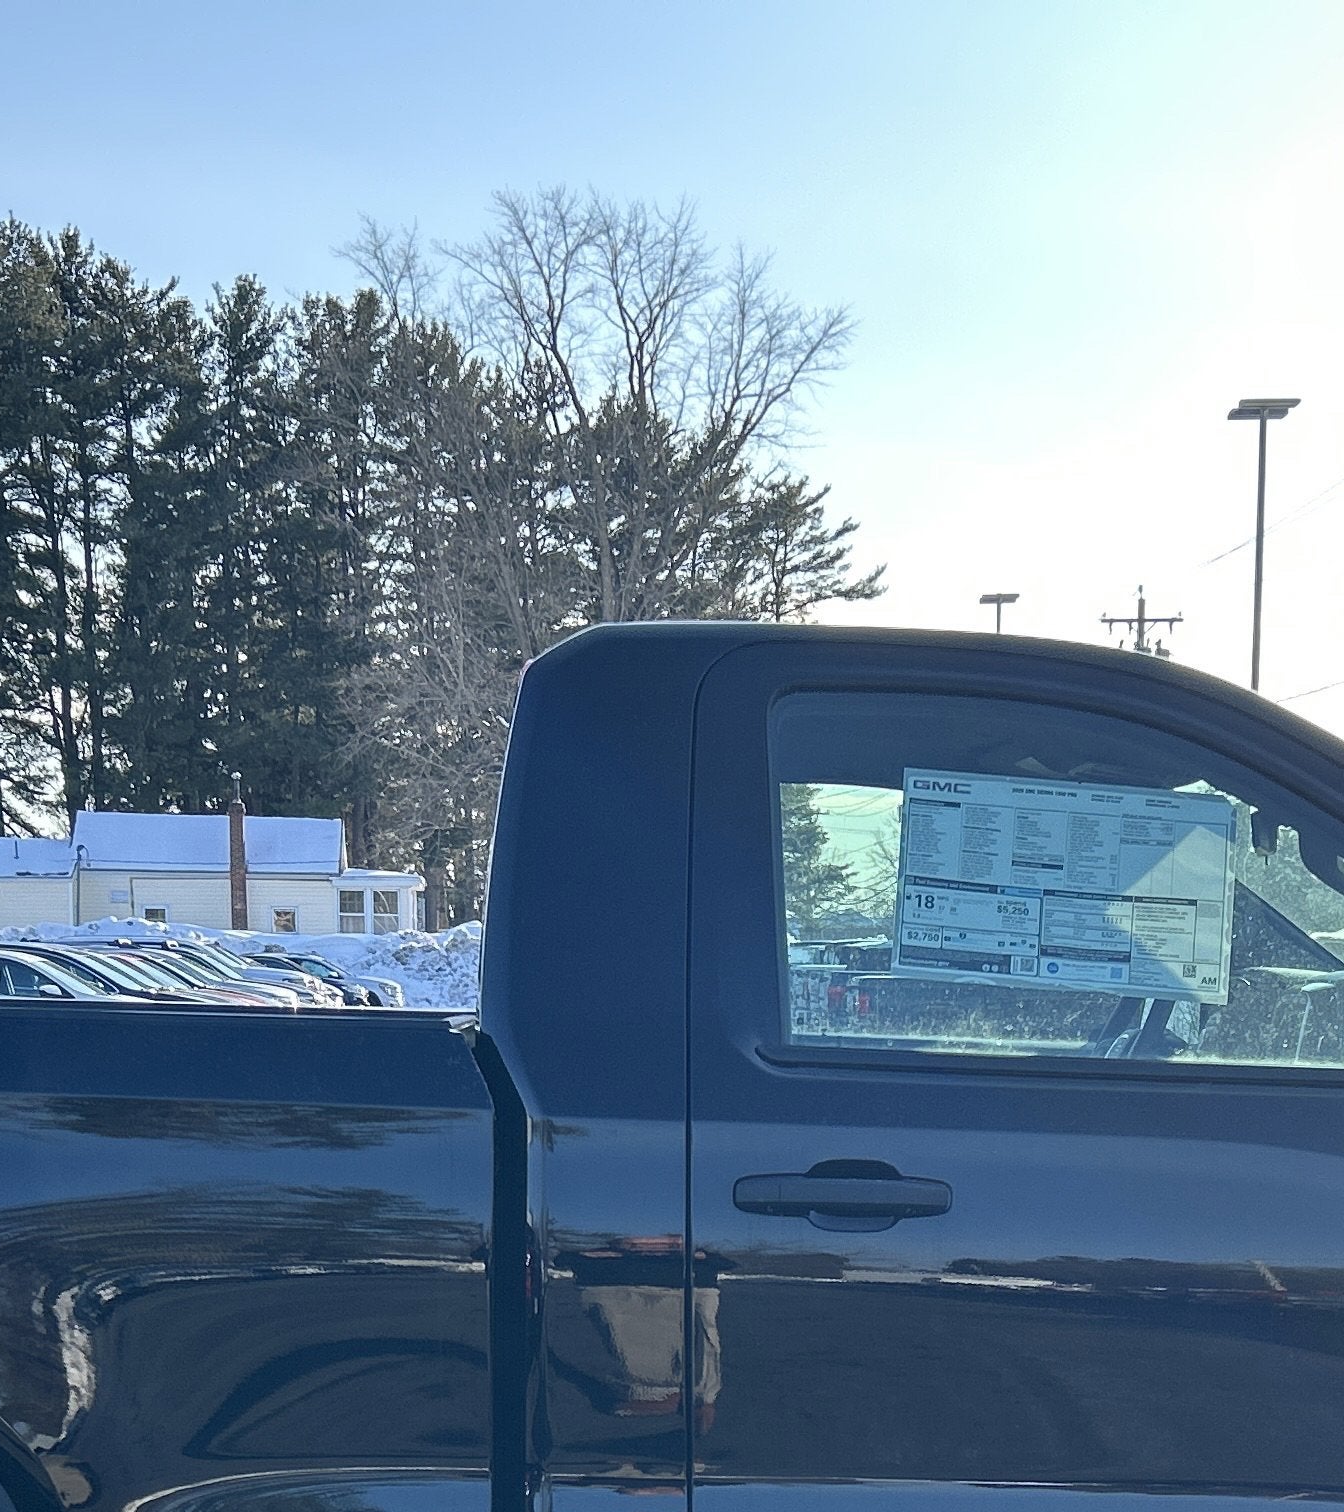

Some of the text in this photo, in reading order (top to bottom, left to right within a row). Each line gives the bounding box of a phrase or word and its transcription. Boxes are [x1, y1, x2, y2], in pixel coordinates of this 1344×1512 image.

[913, 779, 972, 795] GMC
[915, 894, 935, 909] 18
[1200, 976, 1218, 986] AM
